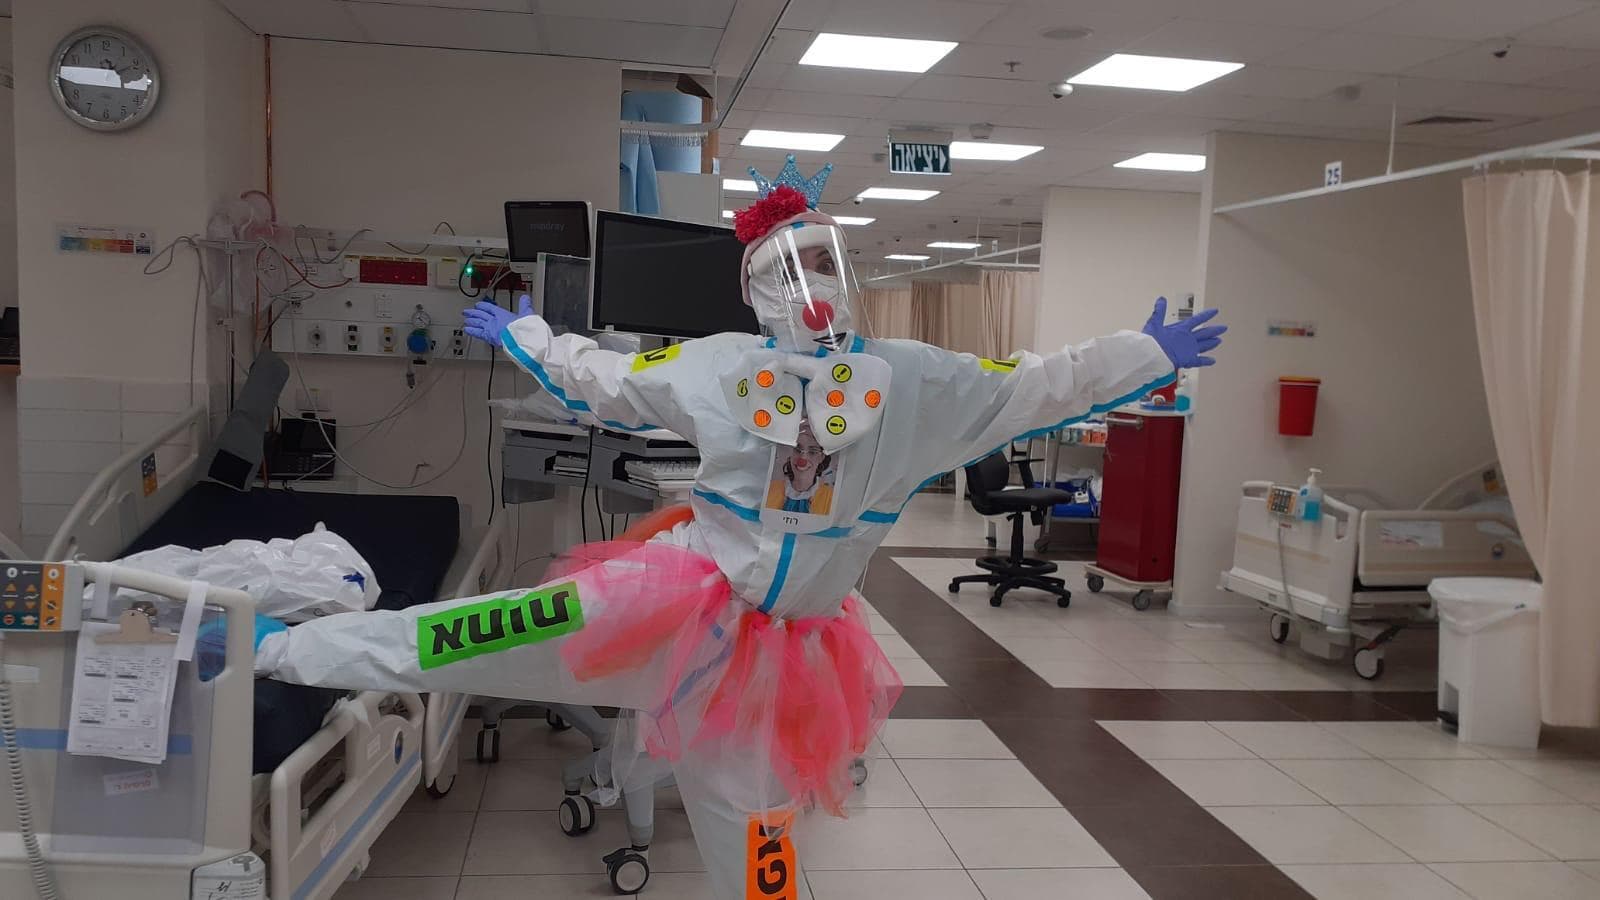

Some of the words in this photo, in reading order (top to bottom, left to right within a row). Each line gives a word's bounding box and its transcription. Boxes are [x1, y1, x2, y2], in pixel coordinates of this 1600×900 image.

[83, 43, 92, 54] 11
[102, 40, 111, 51] 12
[73, 90, 80, 99] 8
[86, 103, 93, 113] 7
[103, 108, 110, 119] 6
[120, 106, 127, 115] 5
[895, 144, 938, 172] יציאה
[1328, 168, 1340, 185] 25
[783, 516, 799, 526] רוזי
[430, 591, 569, 656] אחות
